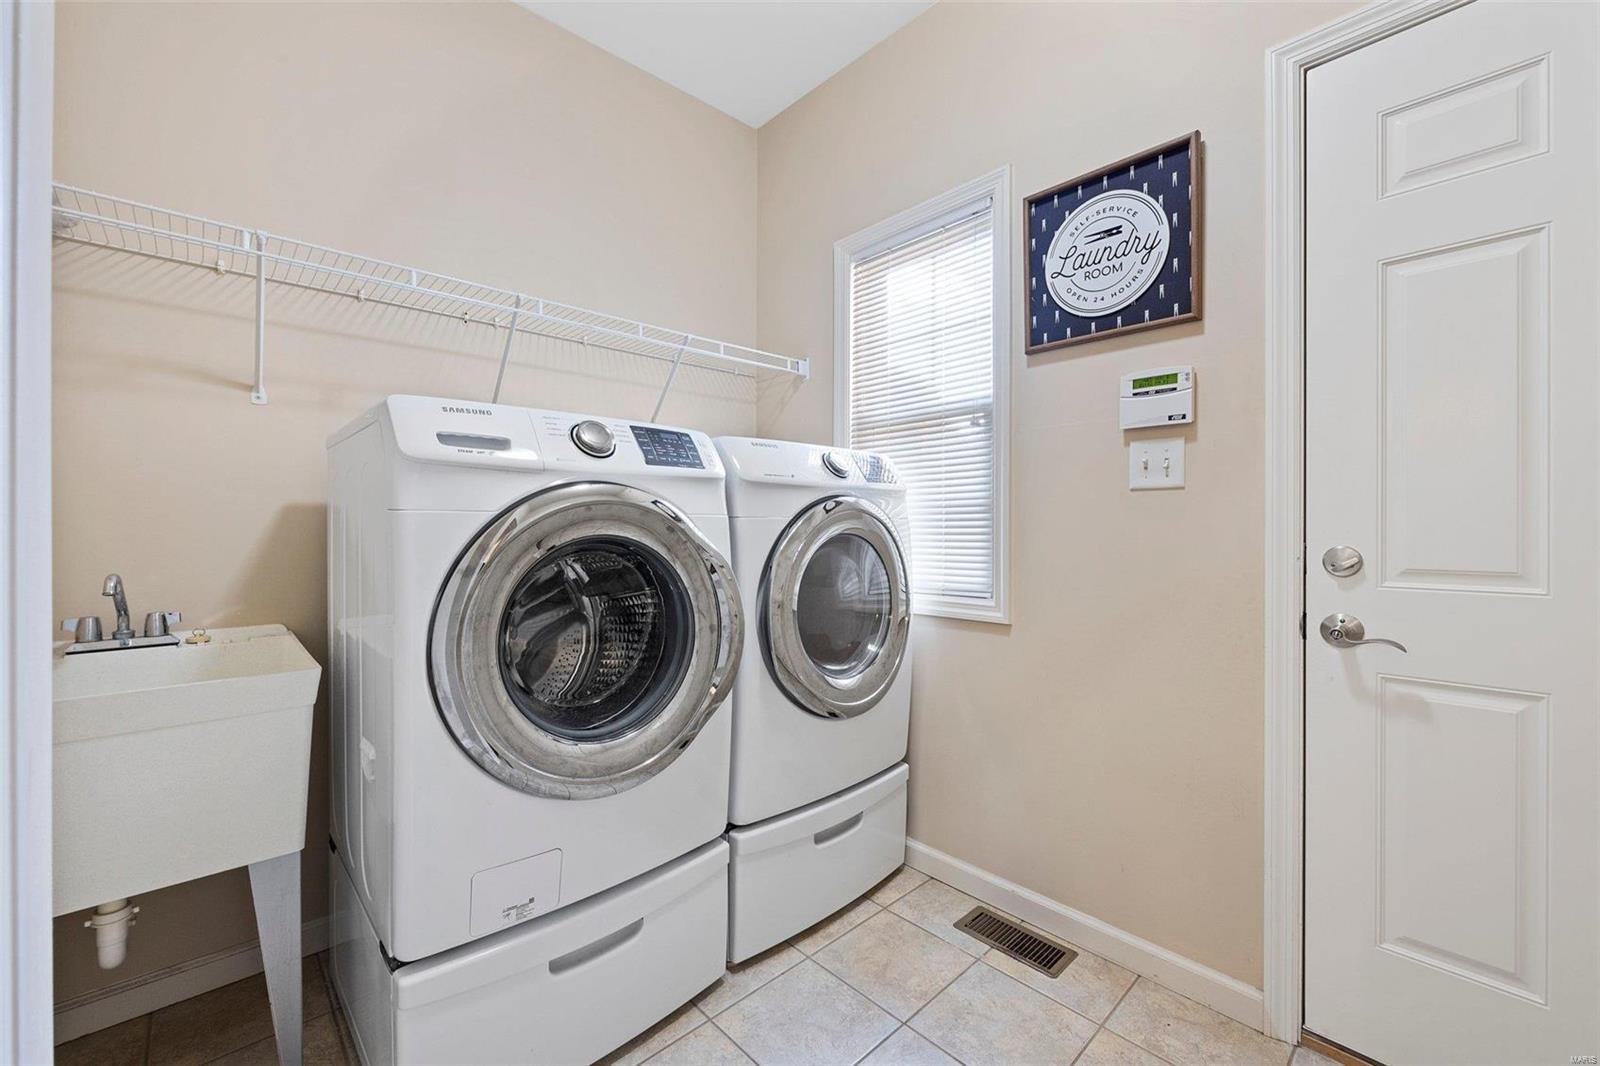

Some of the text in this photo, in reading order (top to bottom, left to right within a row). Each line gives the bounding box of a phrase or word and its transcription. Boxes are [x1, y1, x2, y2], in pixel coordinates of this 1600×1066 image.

[1069, 206, 1138, 238] SELF-SERVICE
[1051, 228, 1162, 279] Laundry
[1066, 287, 1089, 303] OPEN
[1110, 268, 1144, 299] HOURS
[1084, 262, 1123, 281] ROOM
[442, 406, 493, 416] SAMSUNG
